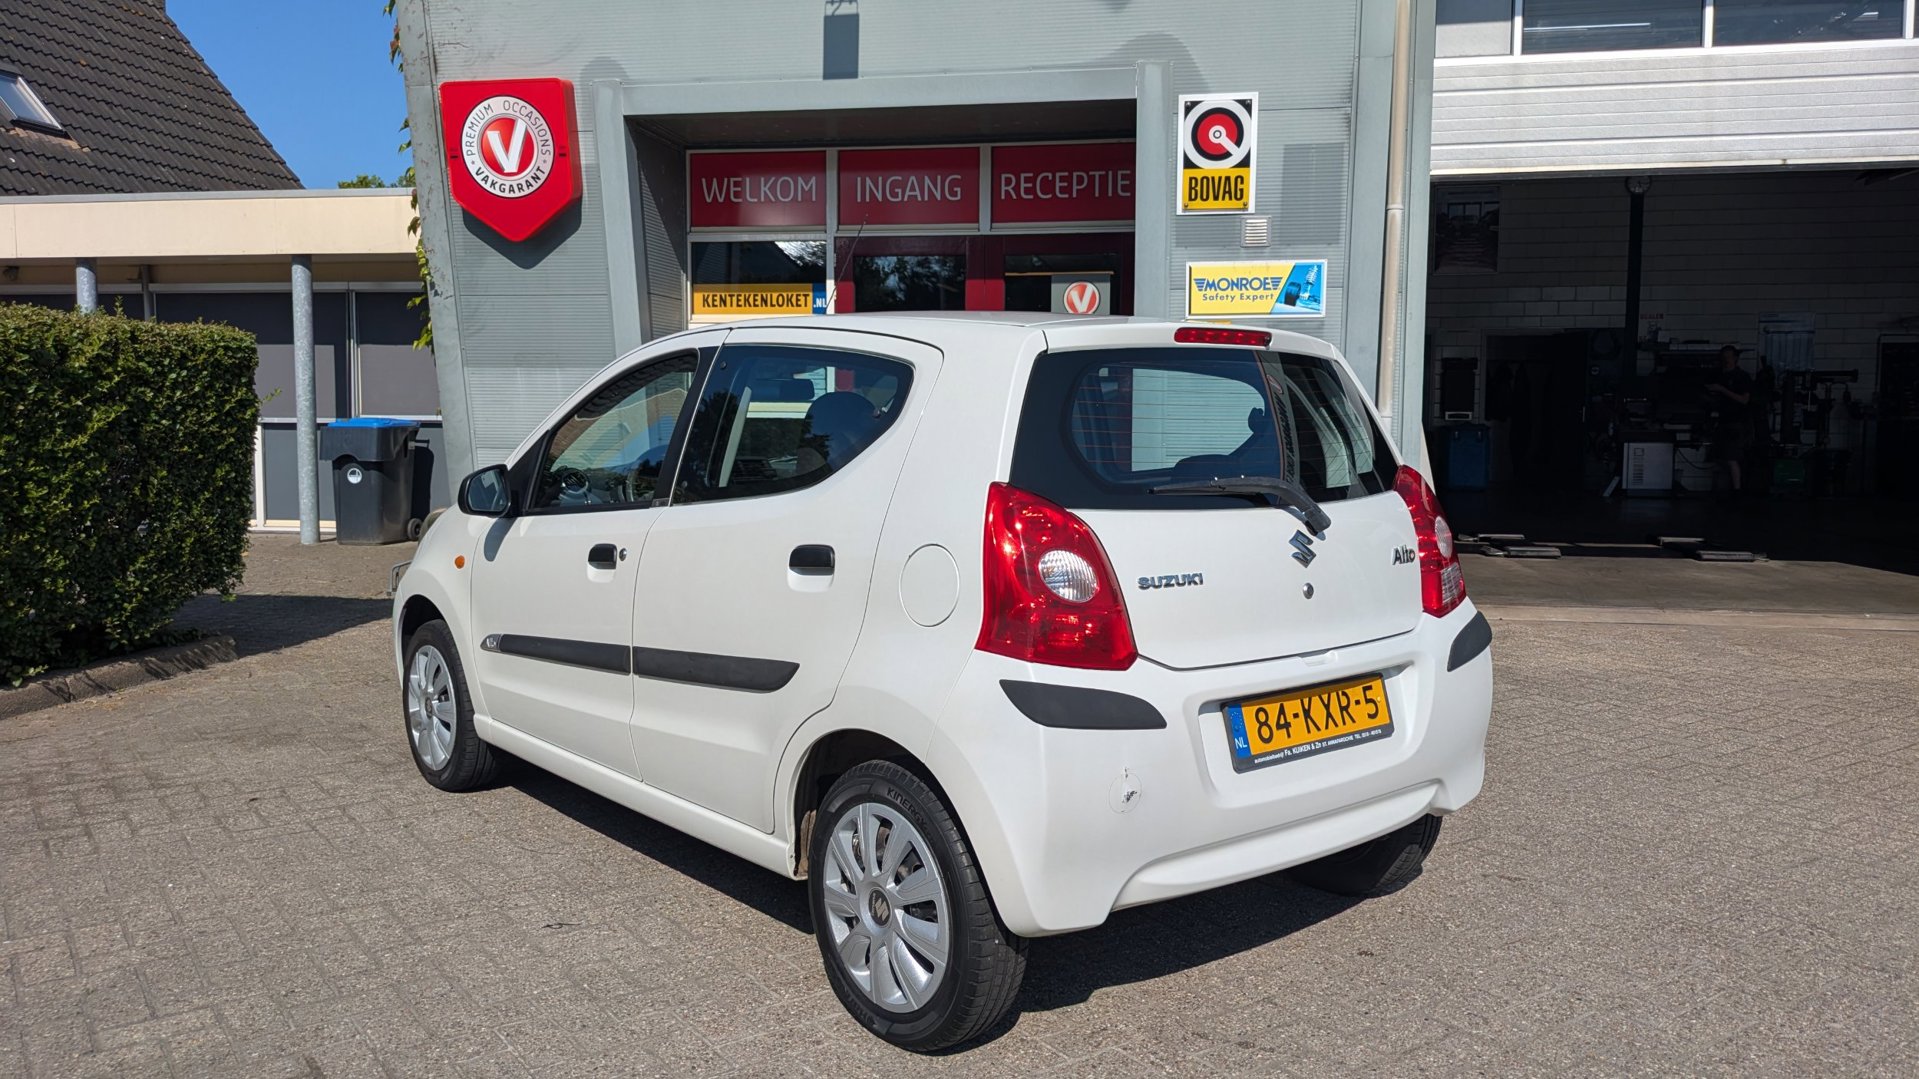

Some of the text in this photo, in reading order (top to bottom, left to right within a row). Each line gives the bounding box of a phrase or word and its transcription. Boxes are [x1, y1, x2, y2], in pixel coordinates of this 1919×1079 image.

[465, 99, 552, 157] PREMIUM OCCASIONS
[475, 166, 546, 195] VAKGARANT
[701, 176, 817, 203] WELKOM
[856, 174, 962, 203] INGANG
[1000, 169, 1132, 200] RECEPTIE
[1187, 174, 1245, 202] BOVAG
[1202, 292, 1275, 303] Safety Expert
[1203, 276, 1272, 292] MONROE
[1391, 544, 1416, 566] Alto
[1137, 572, 1204, 591] SUZUKI
[1254, 684, 1380, 744] 84-KXR-5
[1234, 737, 1248, 750] NL
